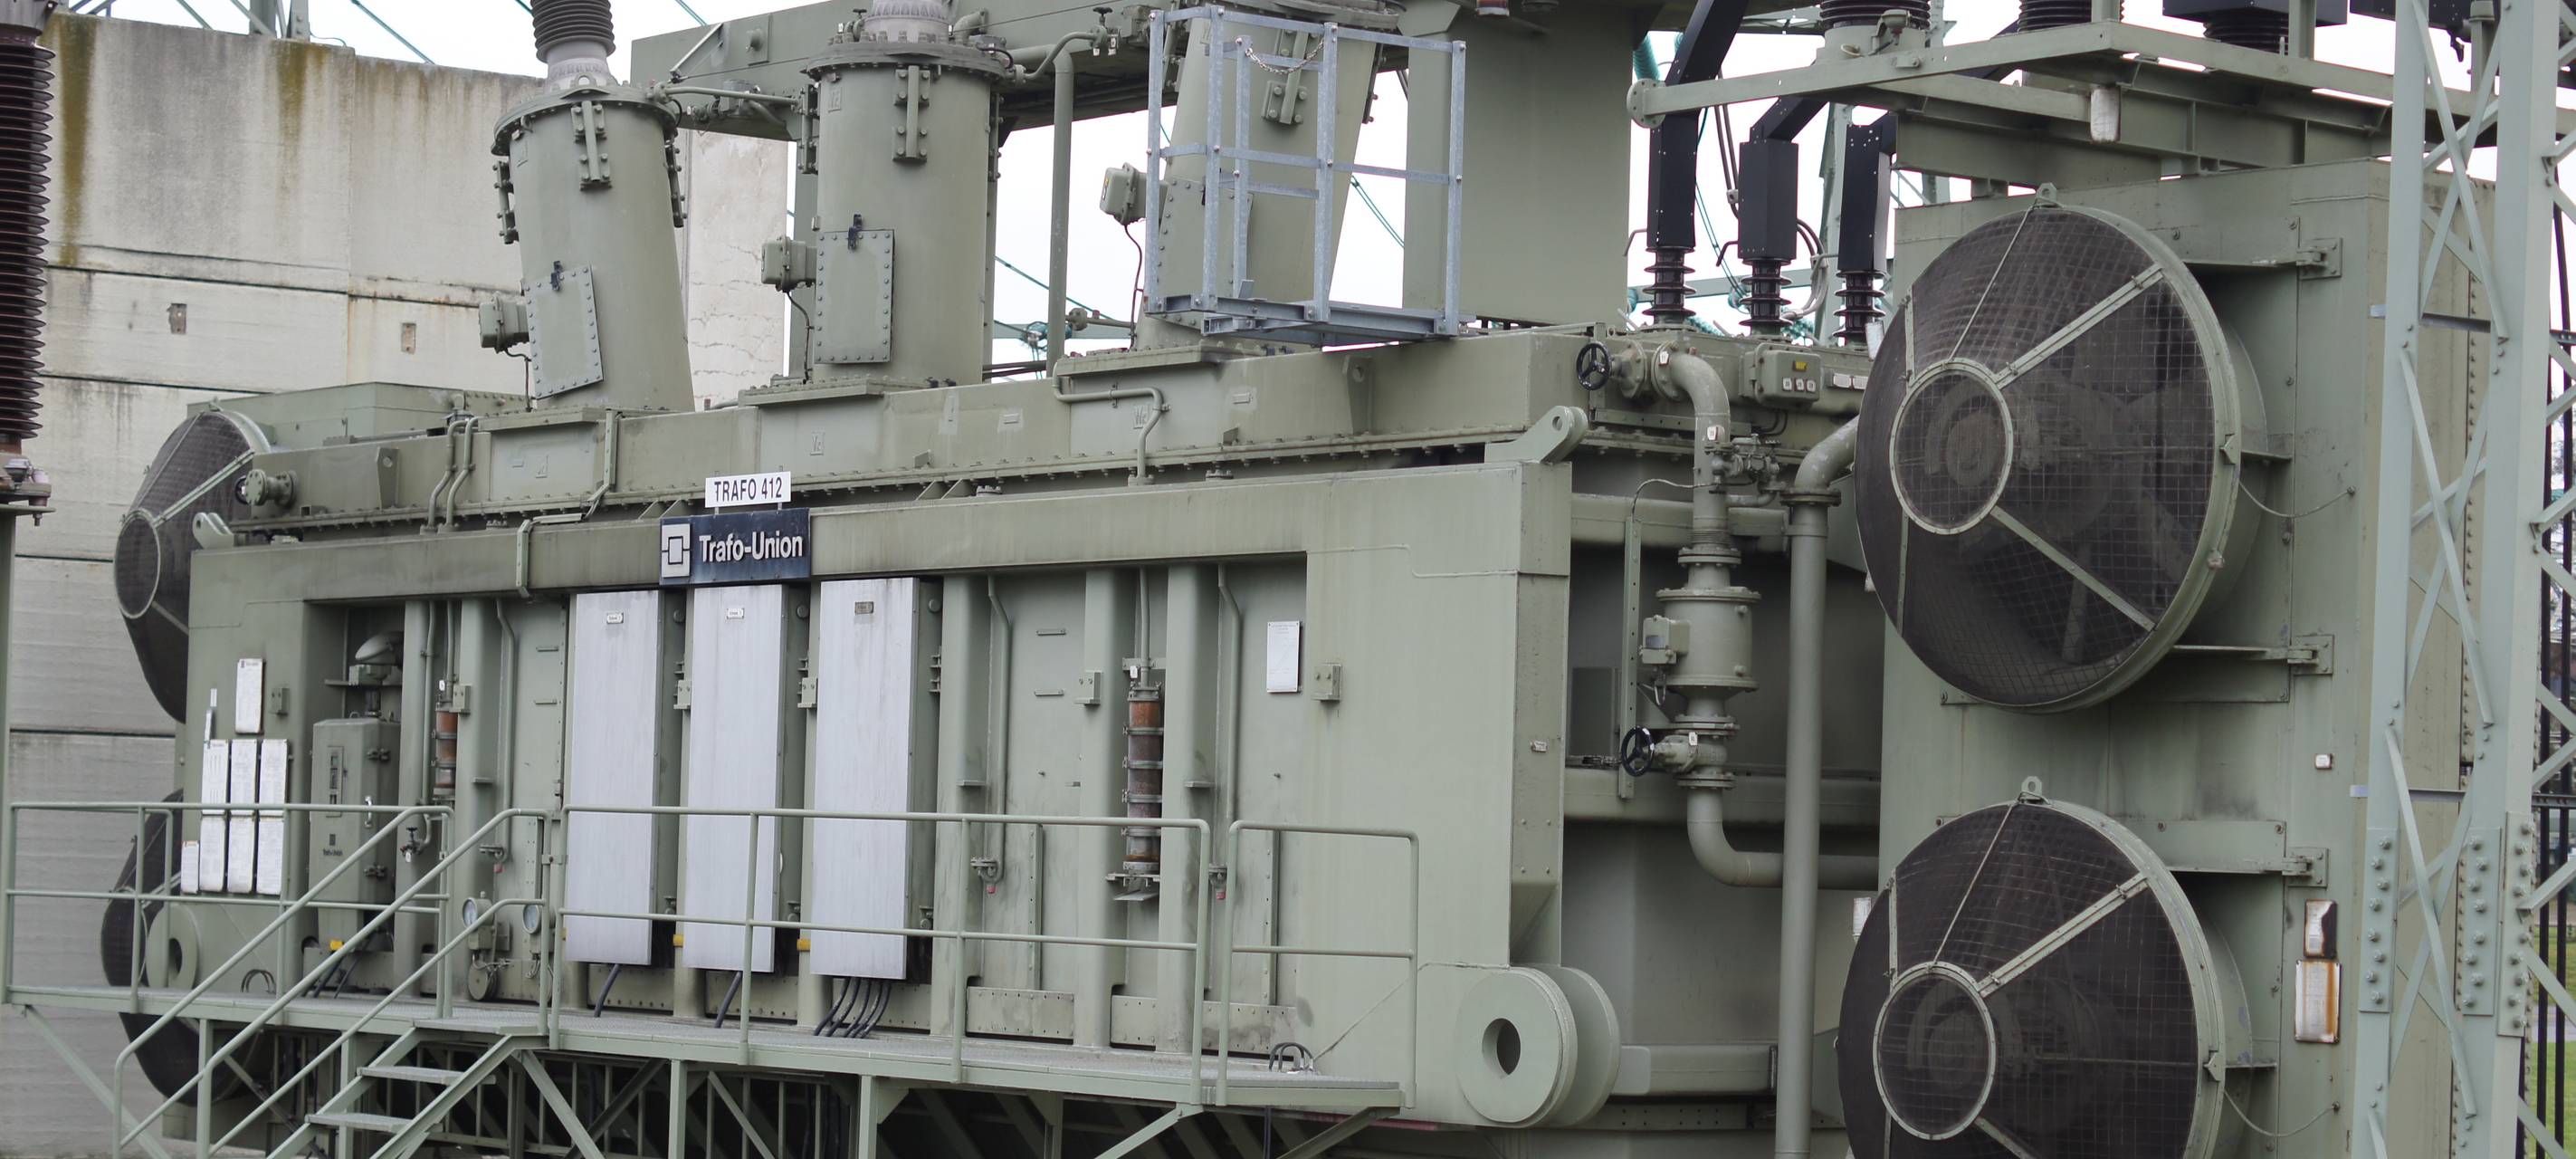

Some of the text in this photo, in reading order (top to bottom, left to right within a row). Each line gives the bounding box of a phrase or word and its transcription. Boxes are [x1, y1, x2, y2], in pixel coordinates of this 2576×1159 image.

[714, 476, 782, 502] TRAFO 412
[699, 530, 803, 561] Trafo-Union
